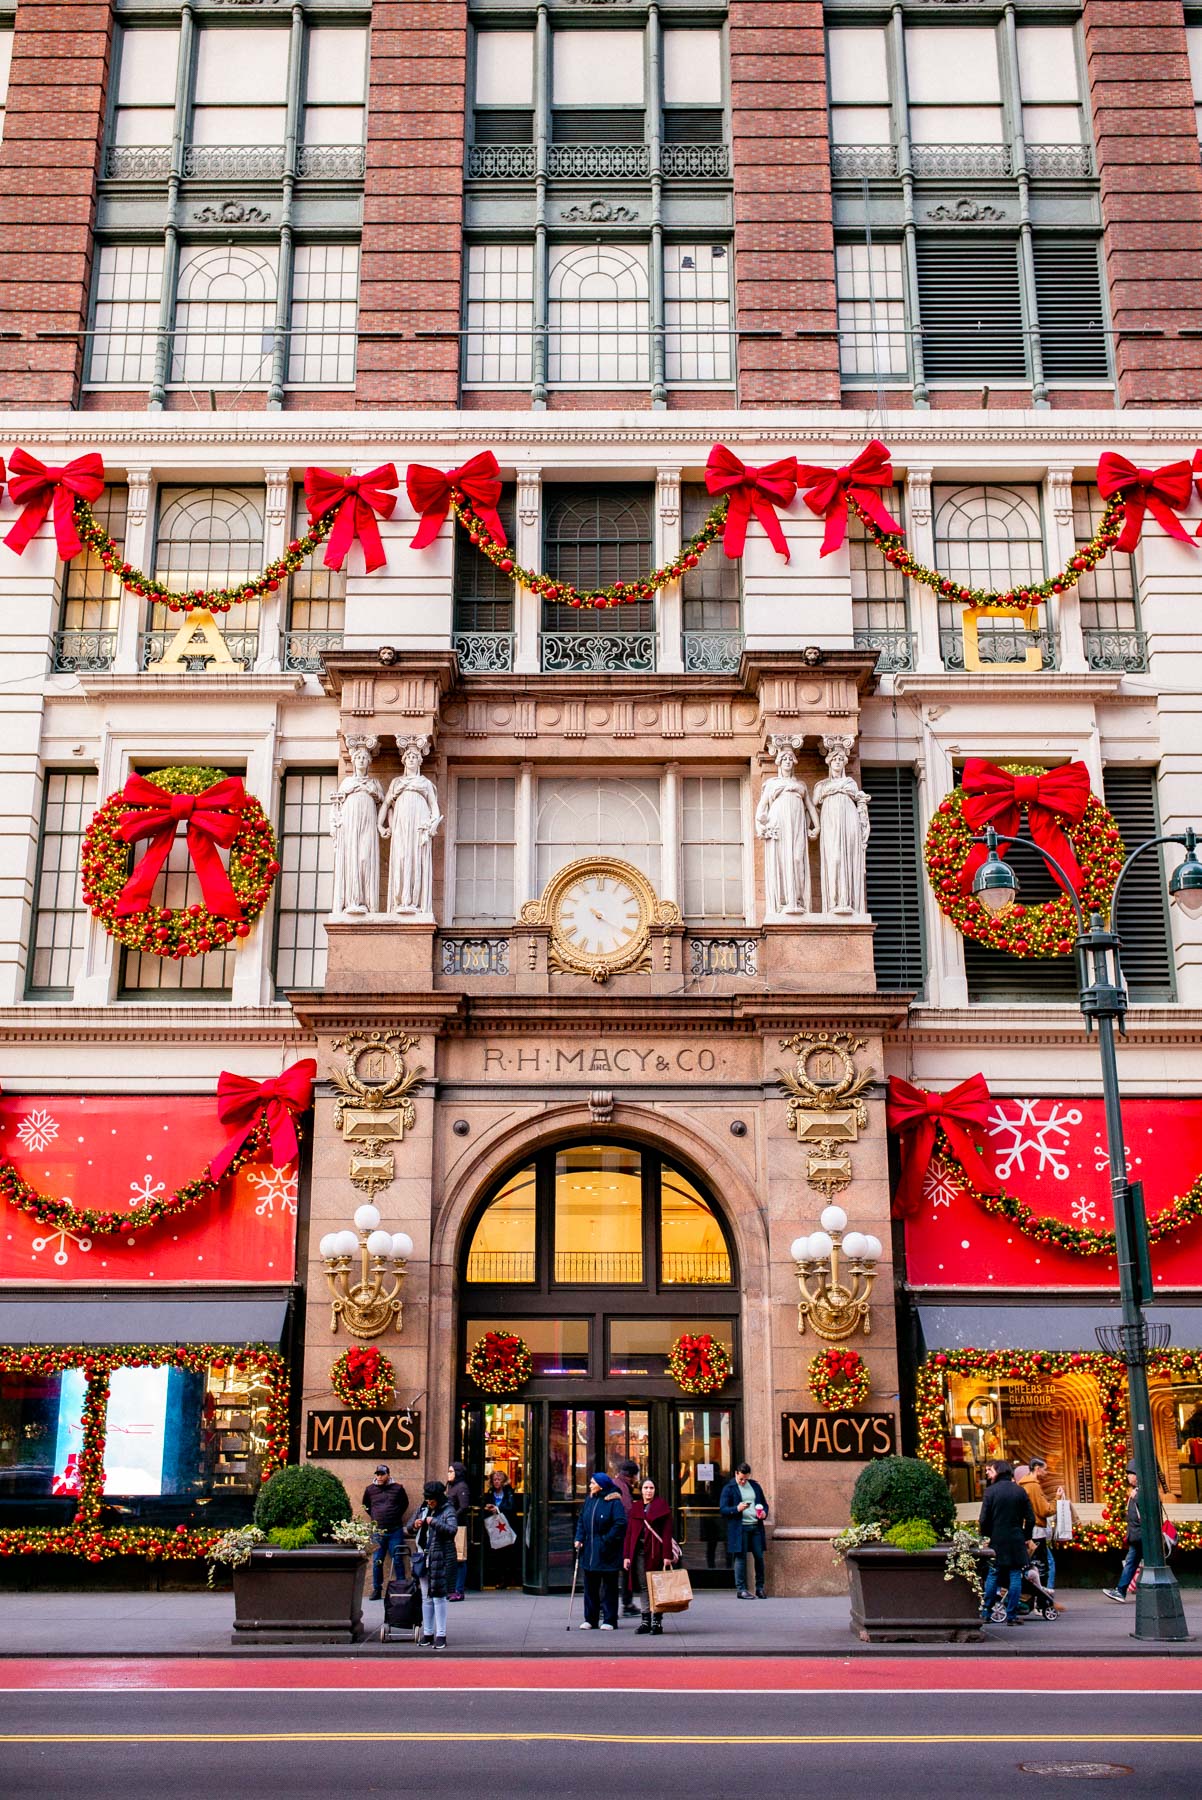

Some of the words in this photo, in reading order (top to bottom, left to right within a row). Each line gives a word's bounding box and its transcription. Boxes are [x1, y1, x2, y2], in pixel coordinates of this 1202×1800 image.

[148, 606, 245, 673] A
[1008, 1384, 1042, 1394] CHEERS
[1044, 1384, 1056, 1394] TO
[1009, 1395, 1052, 1405] GLAMOUR
[312, 1414, 415, 1452] MACY'S
[788, 1416, 891, 1454] MACY'S
